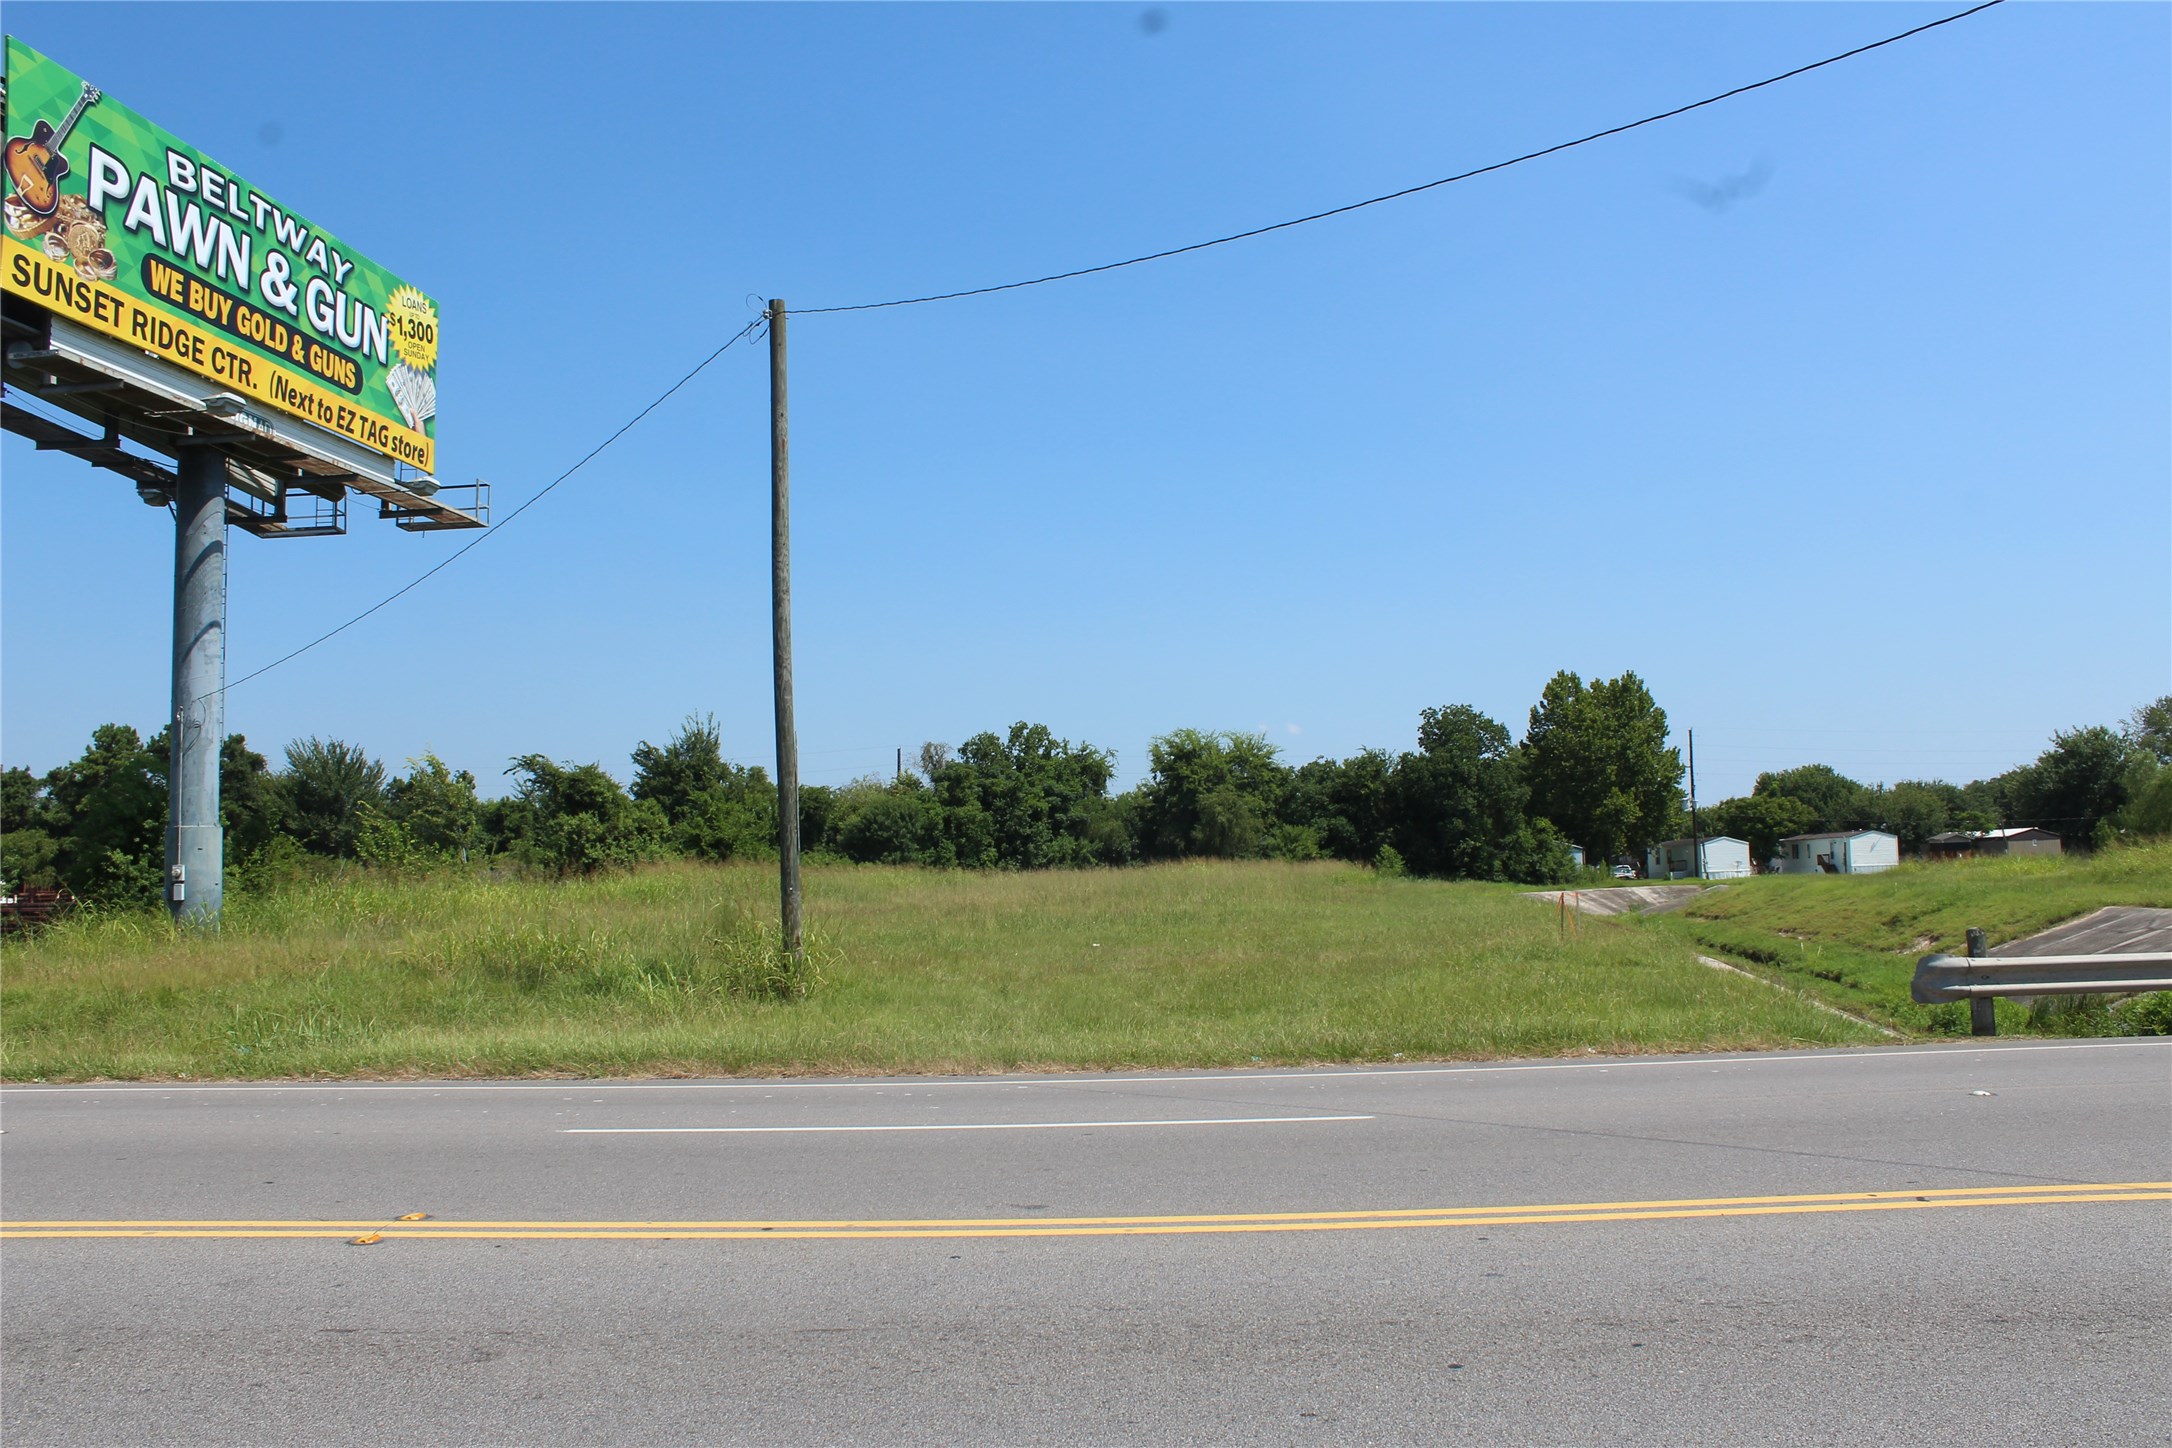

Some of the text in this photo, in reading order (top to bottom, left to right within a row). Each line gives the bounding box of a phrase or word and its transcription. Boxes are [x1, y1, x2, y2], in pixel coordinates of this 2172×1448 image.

[89, 144, 388, 365] PAWN & GUN
[166, 148, 353, 285] BELTWAY
[150, 259, 356, 389] WE BUY GOLD & GUNS
[390, 312, 433, 344] $1,300
[401, 296, 427, 314] LOANS
[11, 254, 429, 467] SUNSET RIDGE CTR. (Next to EZ TAG store)
[403, 348, 429, 360] SUNDAY
[407, 341, 425, 352] OPEN
